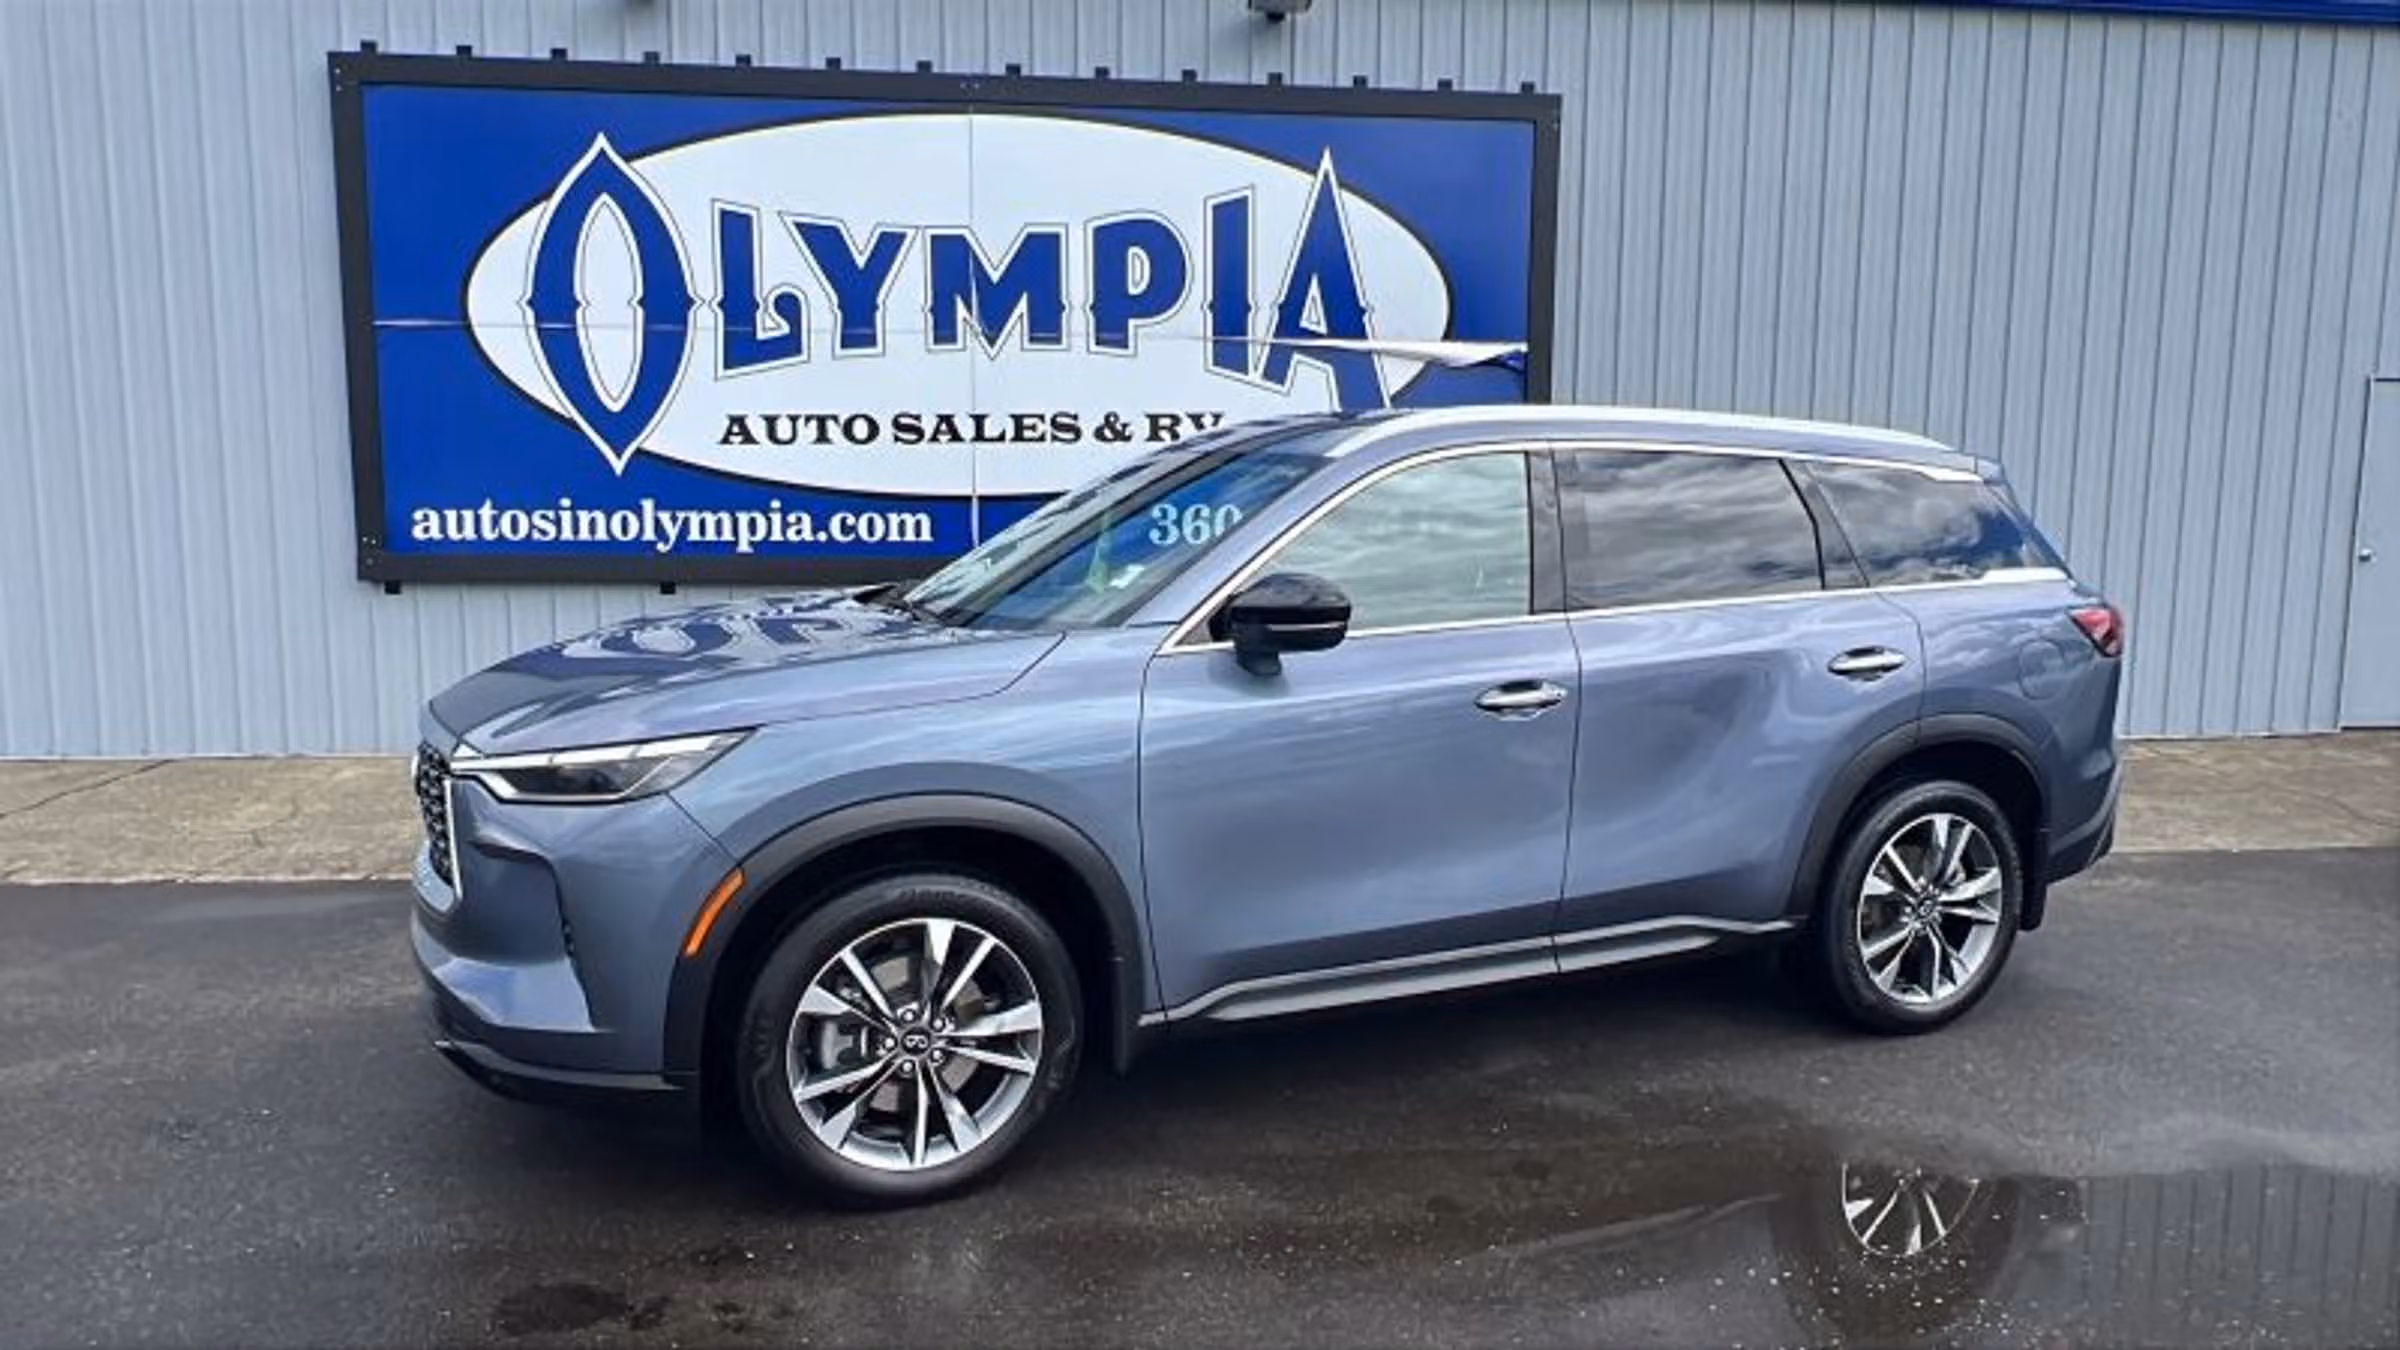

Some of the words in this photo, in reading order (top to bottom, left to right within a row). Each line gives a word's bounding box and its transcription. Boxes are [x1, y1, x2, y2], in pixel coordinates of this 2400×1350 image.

[520, 131, 1392, 476] OLYMPIA
[719, 412, 881, 445] AUTO
[891, 411, 1082, 444] SALES
[1093, 411, 1133, 442] &
[411, 497, 934, 553] autosinolympia.com
